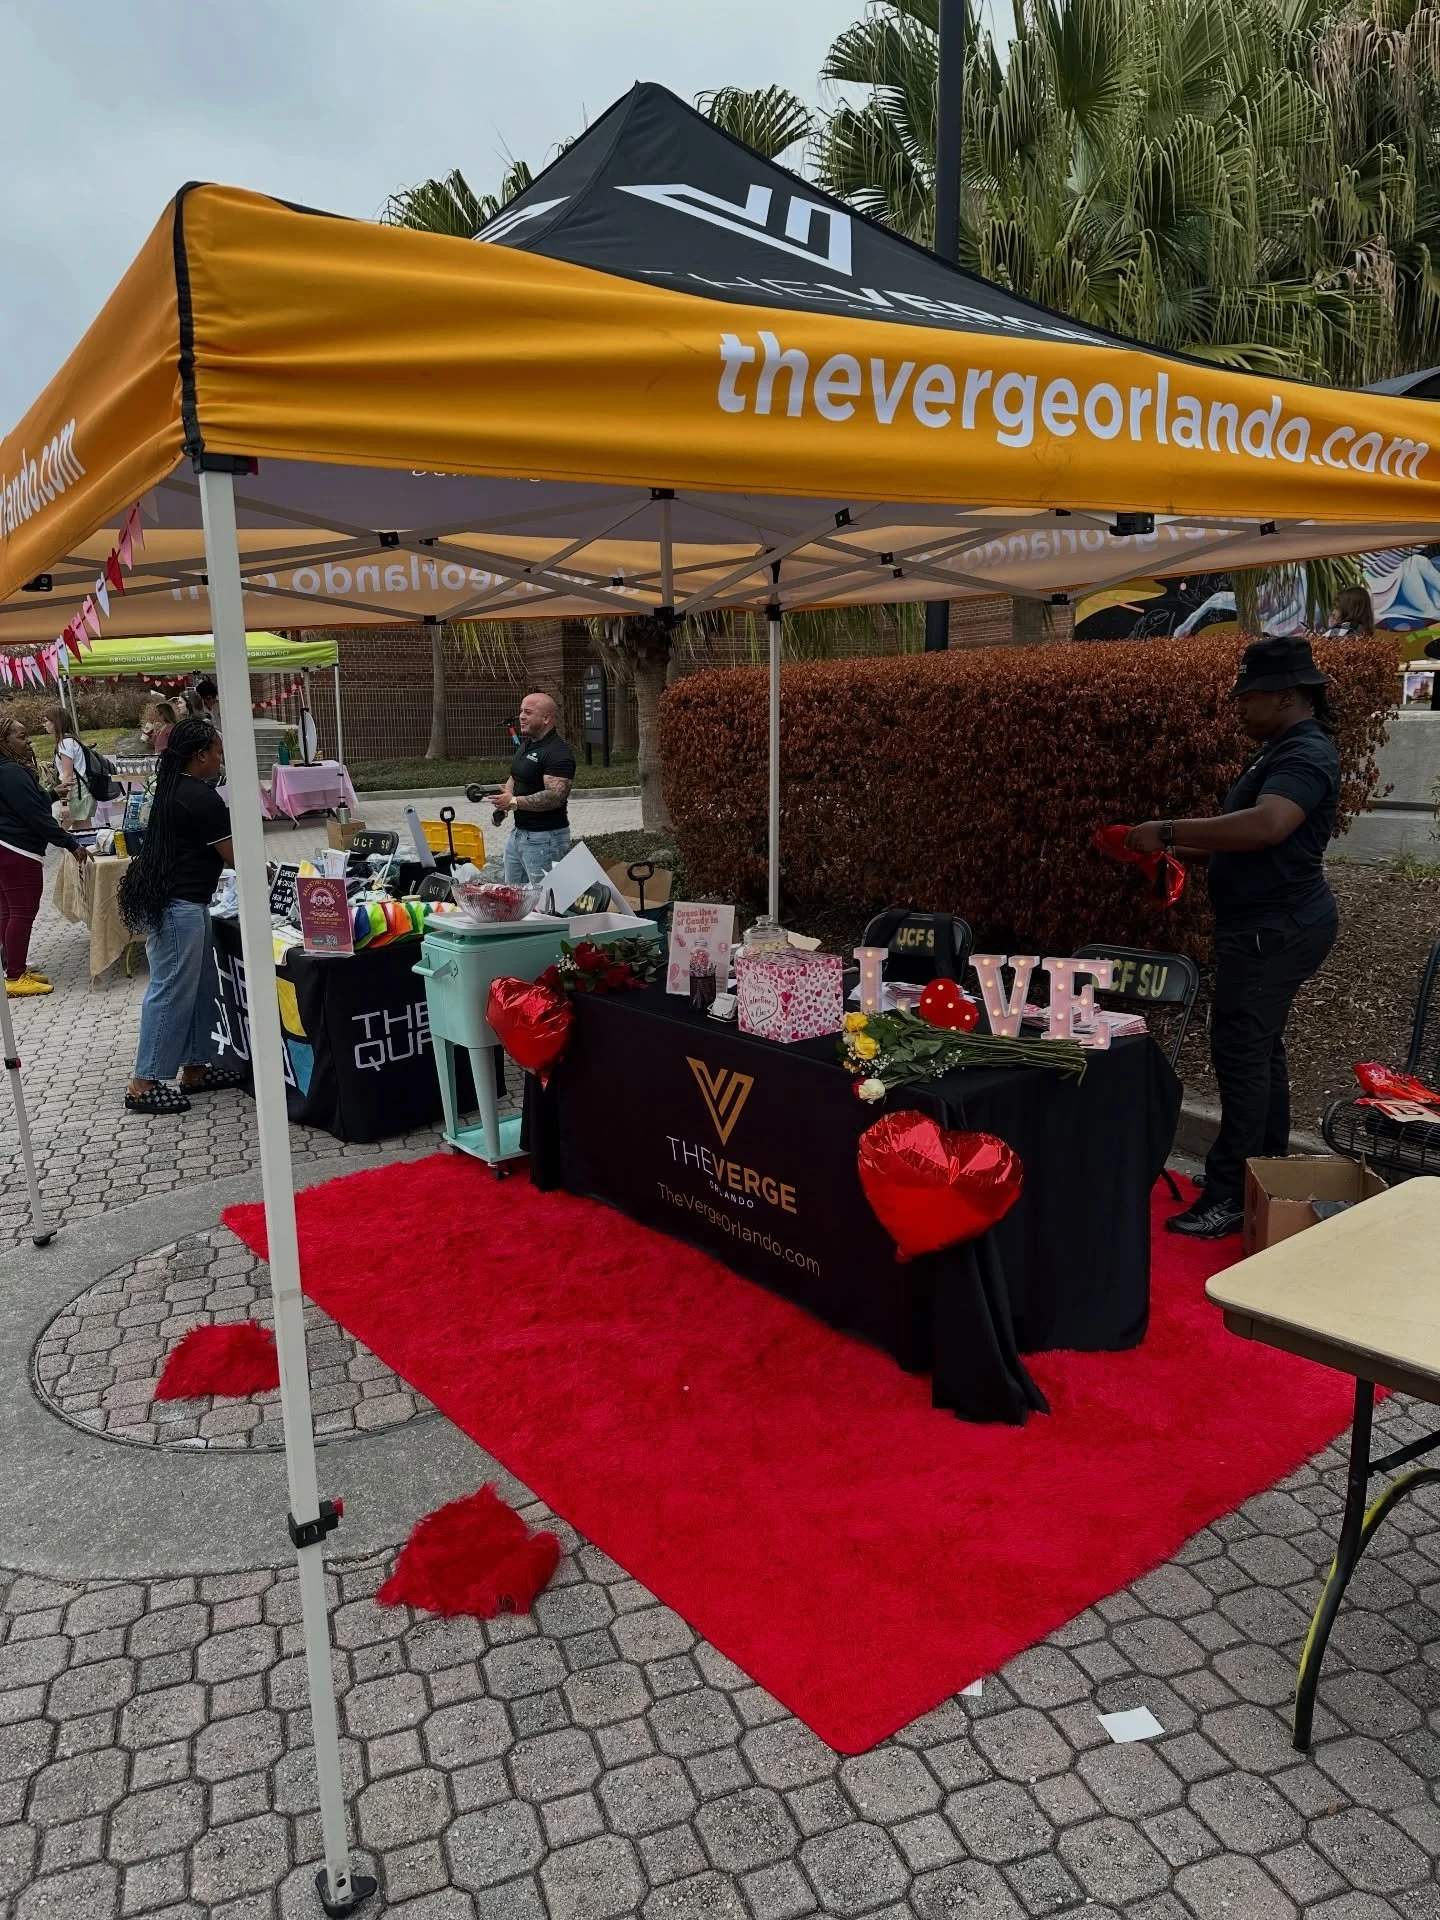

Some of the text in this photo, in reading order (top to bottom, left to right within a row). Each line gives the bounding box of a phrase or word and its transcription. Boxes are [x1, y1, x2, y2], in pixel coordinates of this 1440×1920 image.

[717, 331, 1430, 480] thevergeorlando.com
[353, 837, 374, 848] UCF
[676, 909, 698, 918] Guess
[699, 907, 711, 916] the
[676, 915, 718, 926] of Candy in
[684, 926, 697, 934] the
[896, 927, 935, 948] UCF S
[1136, 966, 1168, 998] SU
[351, 1000, 429, 1040] THE
[666, 1135, 798, 1214] THEVERGE
[709, 1179, 754, 1209] ORLANDO
[657, 1181, 821, 1277] TheVergeOrlando.com
